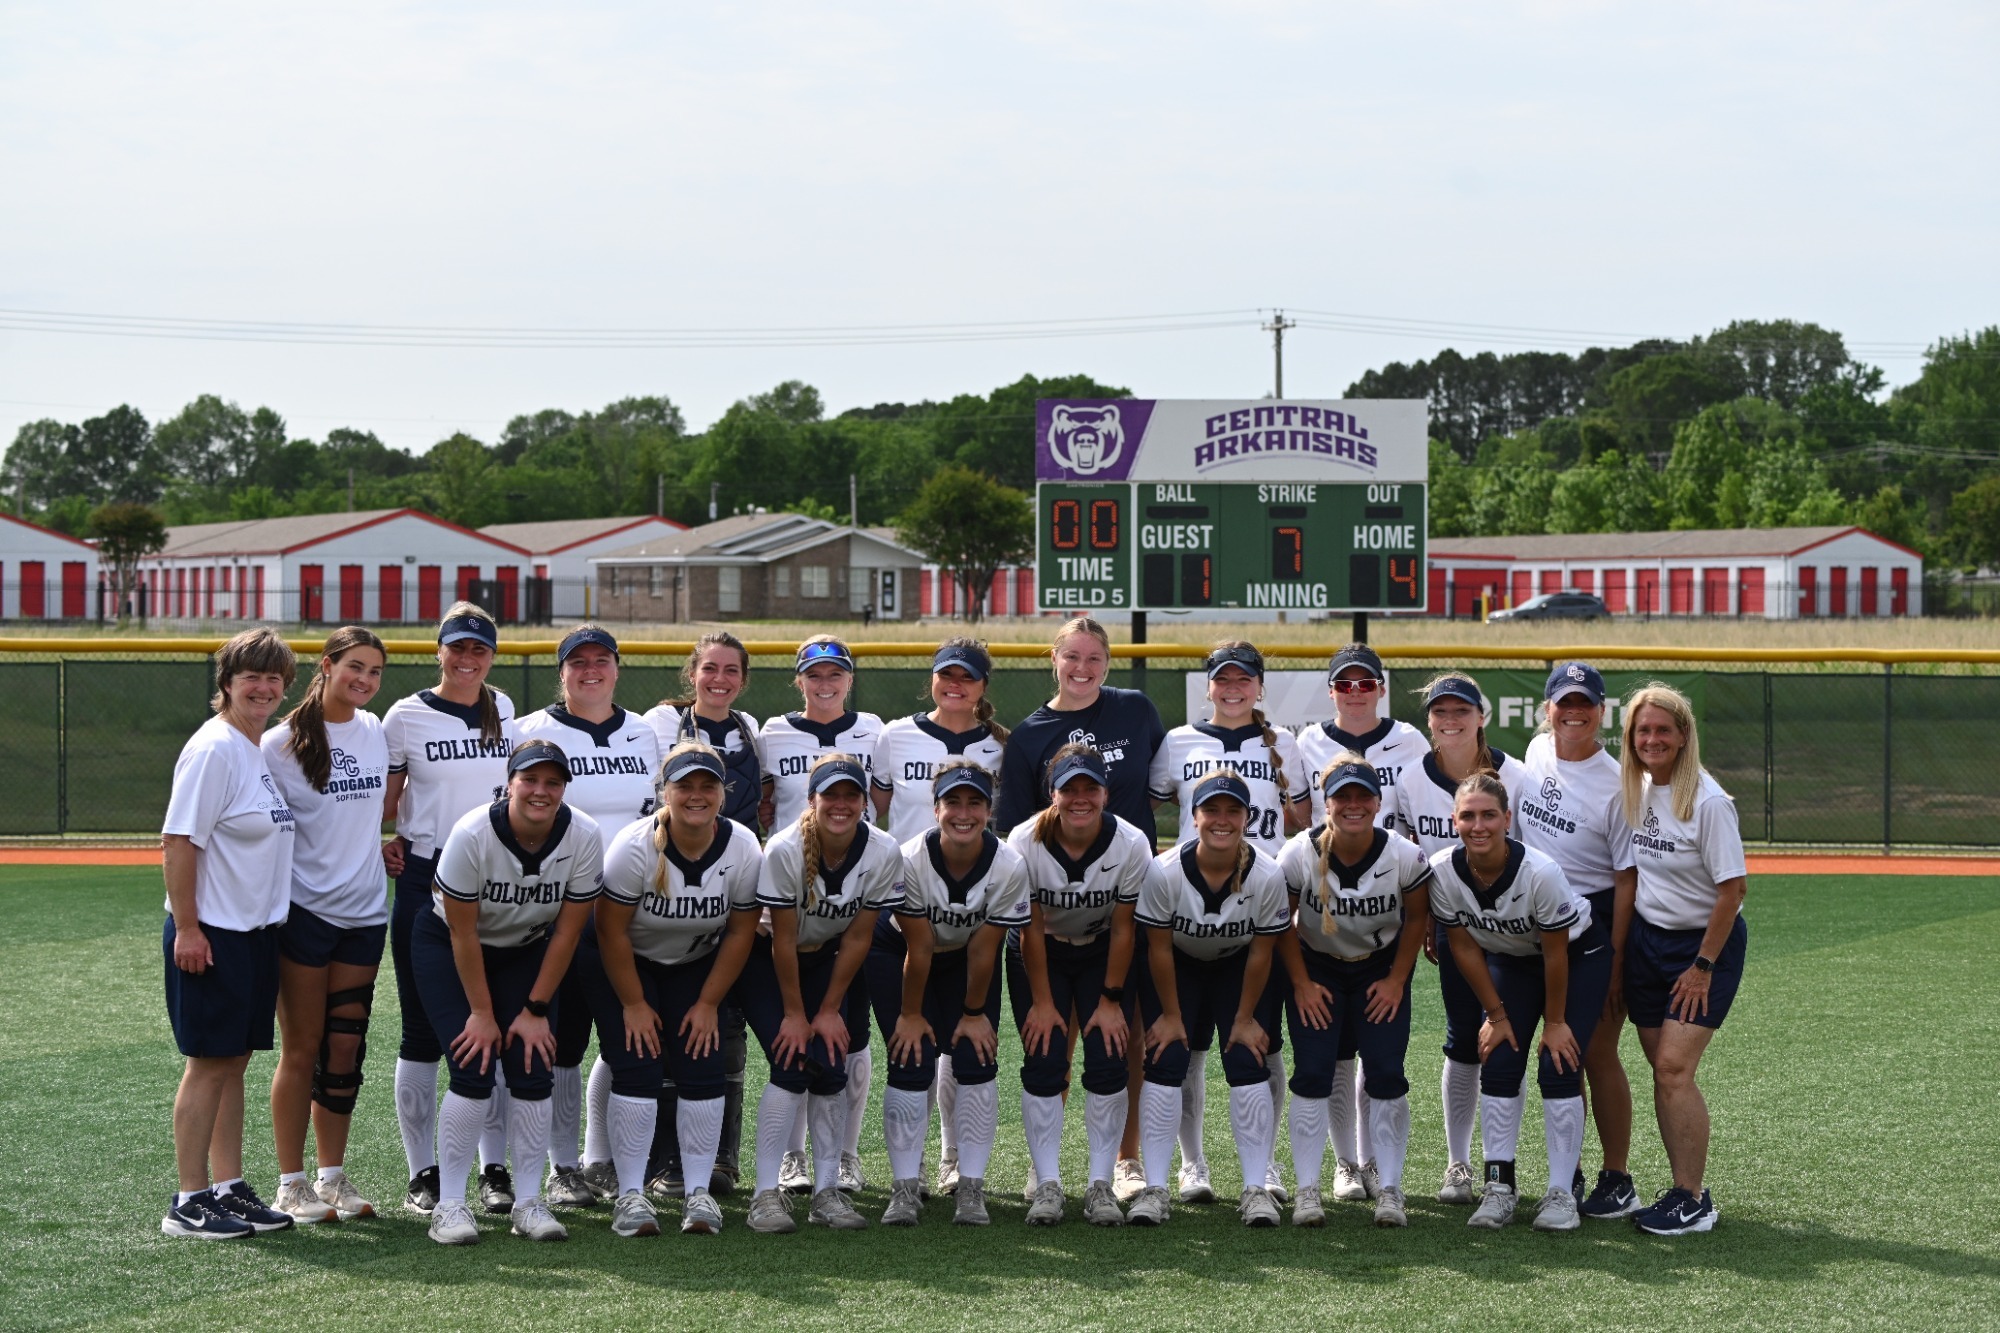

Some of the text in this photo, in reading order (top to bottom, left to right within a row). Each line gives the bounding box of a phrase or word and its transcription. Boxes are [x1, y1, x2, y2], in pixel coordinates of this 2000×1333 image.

[1206, 406, 1368, 440] CENTRAL
[1195, 430, 1377, 468] ARKANSAS
[1156, 485, 1196, 502] BALL
[1258, 485, 1317, 503] STRIKE
[1367, 485, 1401, 503] OUT
[1141, 524, 1213, 549] GUEST
[1353, 525, 1416, 549] HOME
[1278, 528, 1301, 573] 7
[1057, 557, 1114, 581] TIME
[1202, 558, 1210, 600] 1
[1390, 559, 1416, 600] 4
[1045, 588, 1124, 605] FIELD 5
[1246, 583, 1328, 608] INNING
[425, 737, 513, 762] COLUMBI
[570, 756, 649, 776] OLUMBIA
[335, 792, 371, 802] SOFTBALL
[1521, 799, 1577, 834] COUGARS
[1527, 818, 1558, 838] SOFTBALL
[1632, 833, 1676, 853] COUGARS
[482, 879, 562, 906] COLUMBI
[643, 892, 731, 919] COLUMBI
